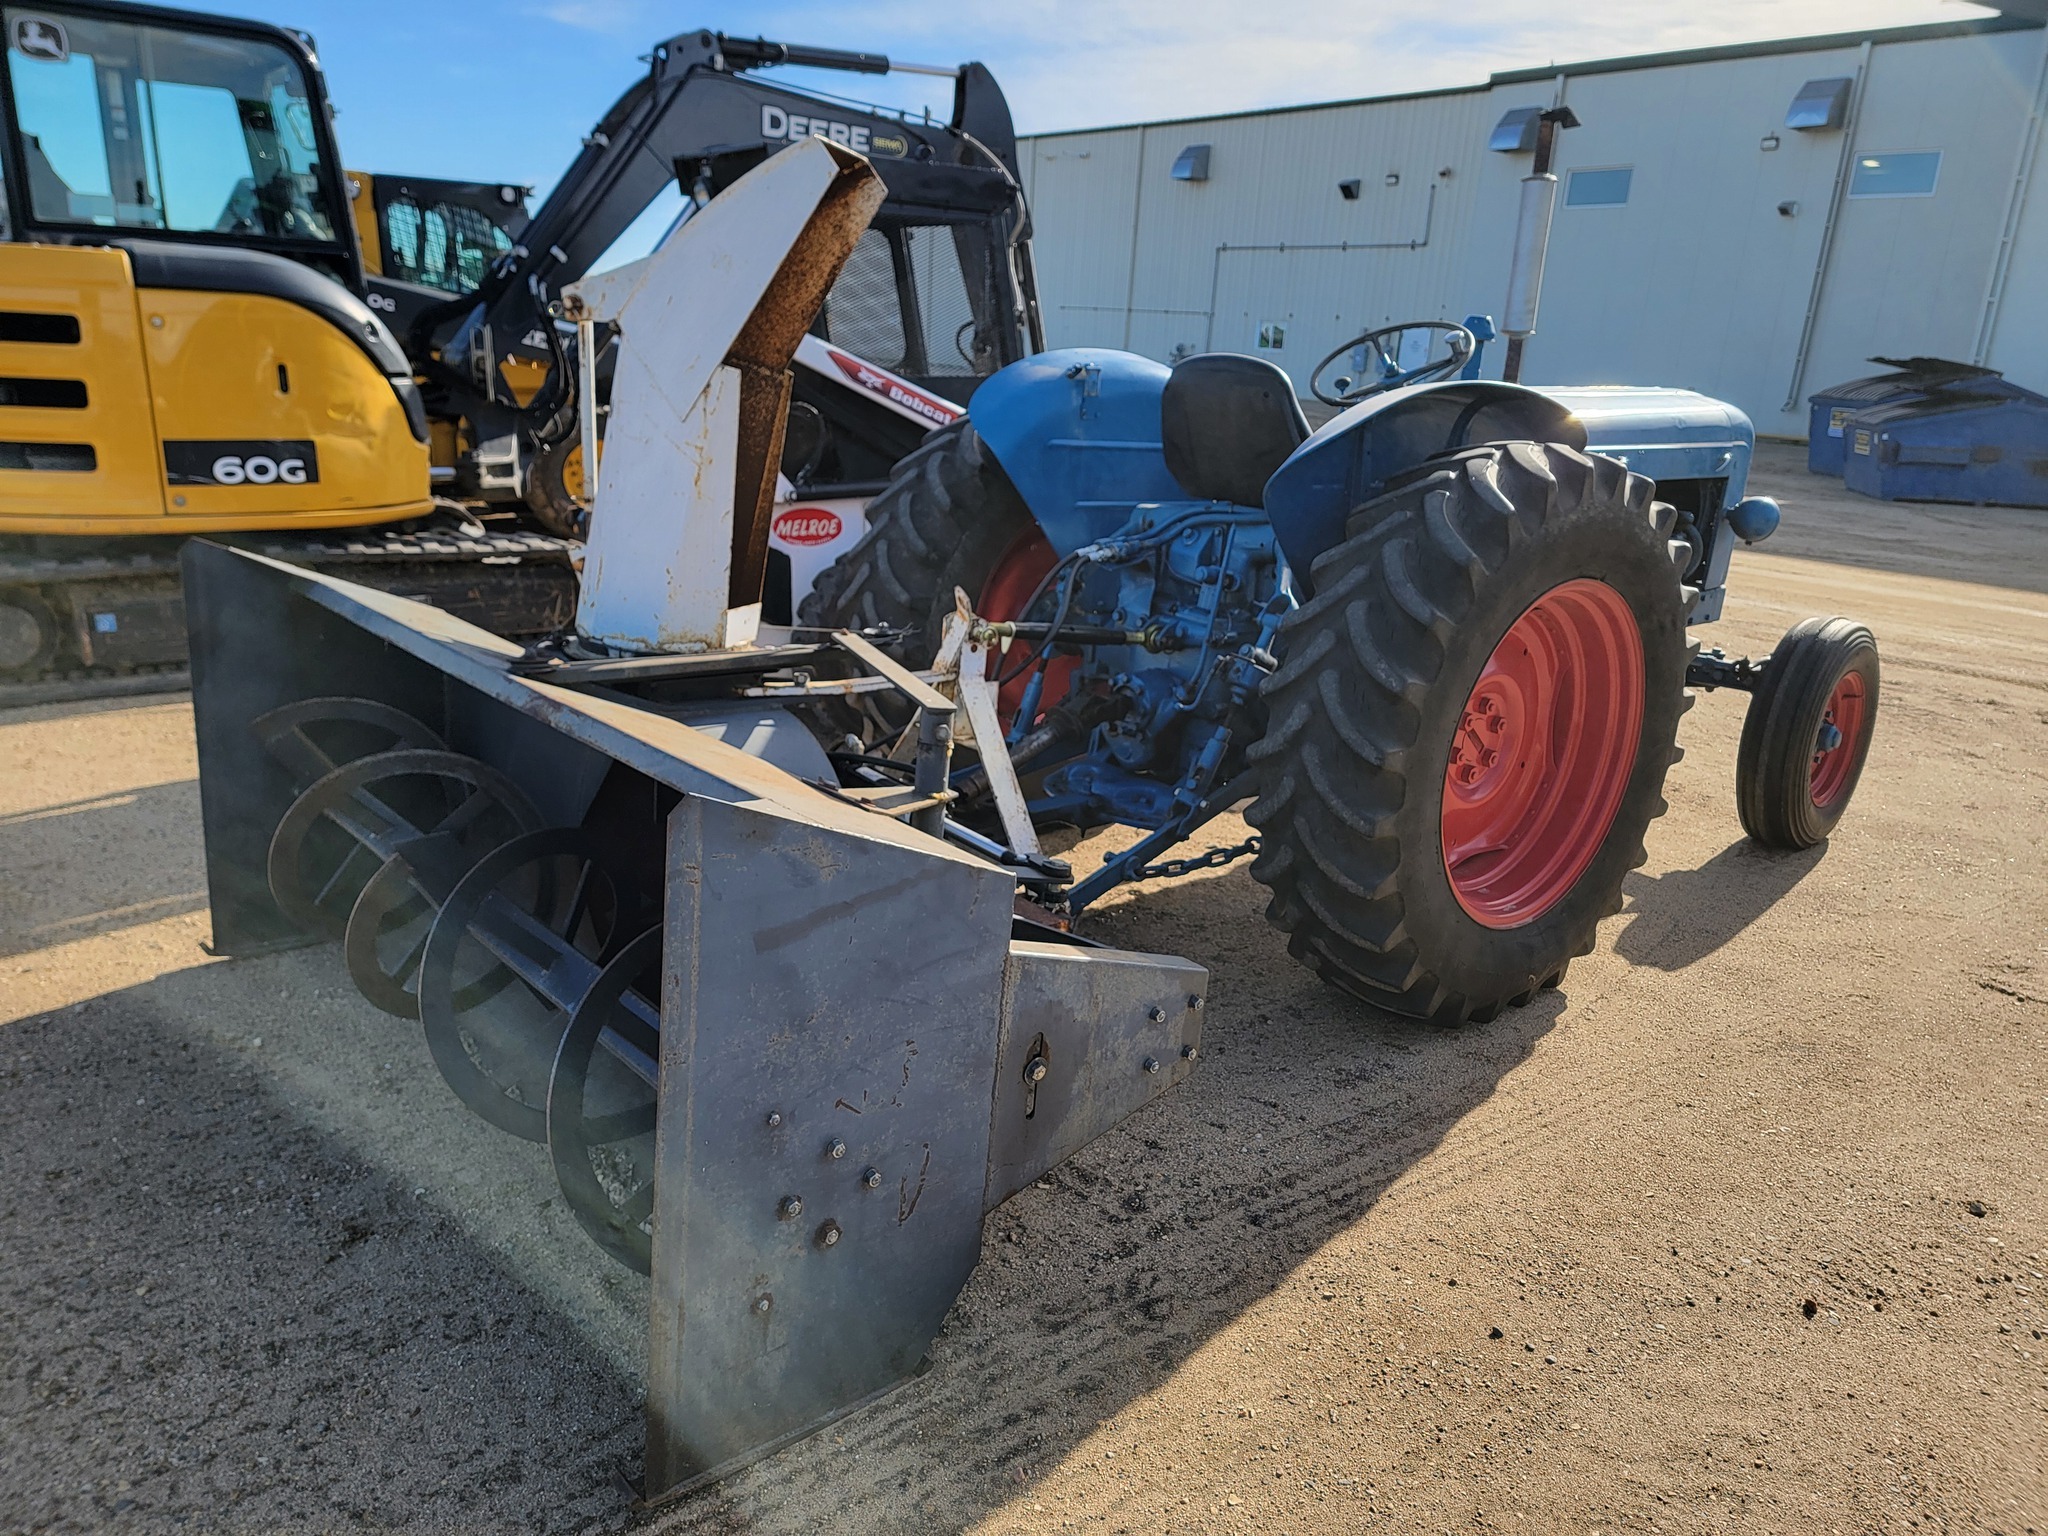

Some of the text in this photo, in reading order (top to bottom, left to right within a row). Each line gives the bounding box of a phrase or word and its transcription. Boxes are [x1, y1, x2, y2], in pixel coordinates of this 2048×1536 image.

[761, 104, 871, 153] DEERE
[888, 385, 953, 427] Bobcat
[212, 455, 308, 485] 60G
[775, 517, 840, 537] MELROE
